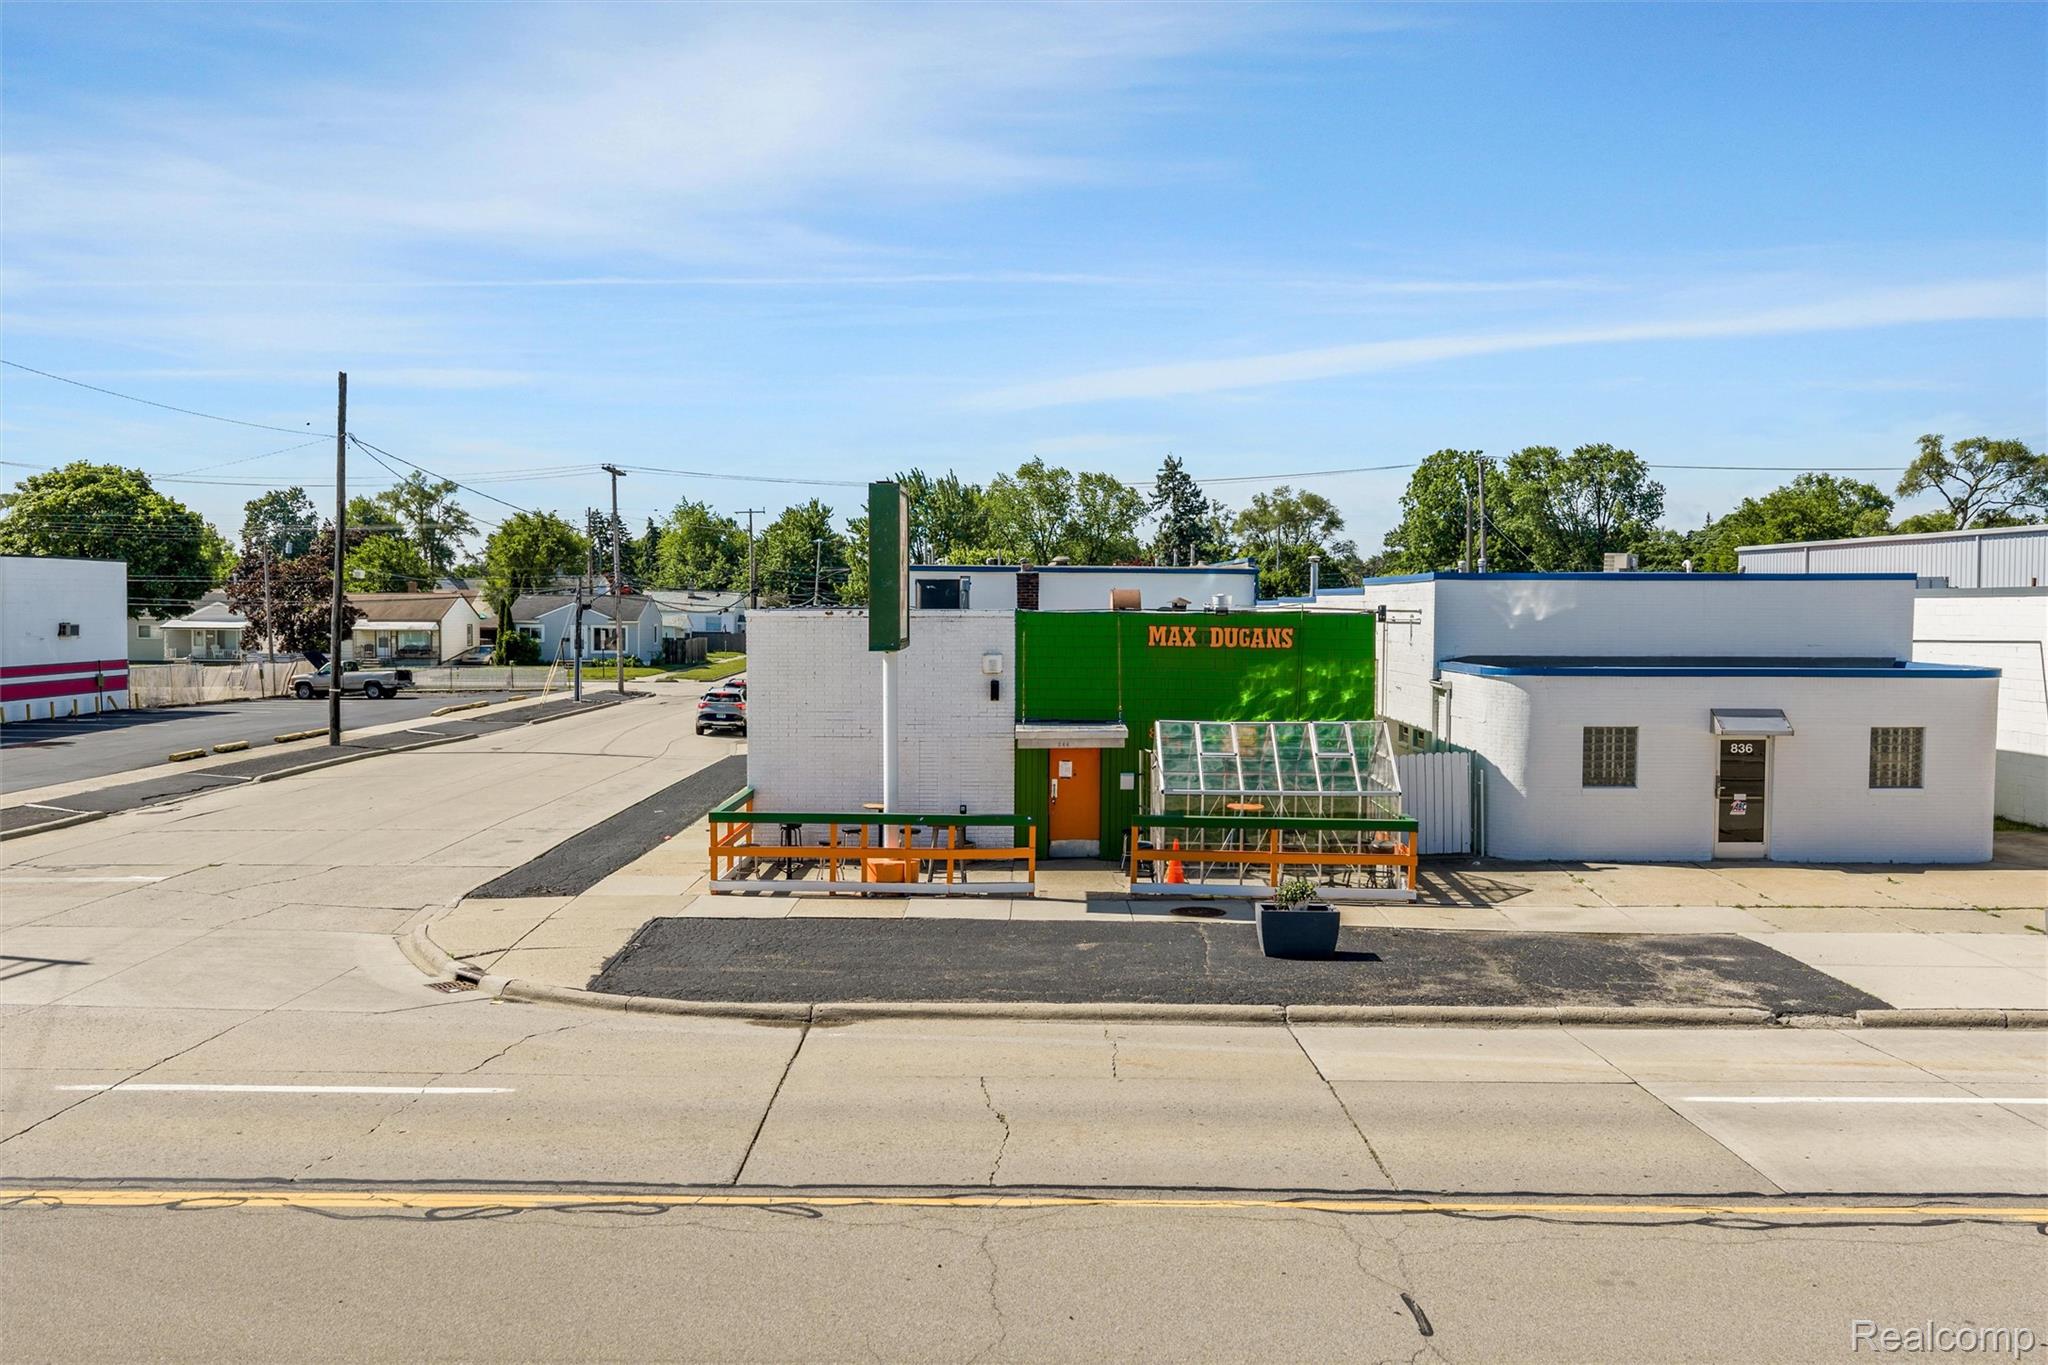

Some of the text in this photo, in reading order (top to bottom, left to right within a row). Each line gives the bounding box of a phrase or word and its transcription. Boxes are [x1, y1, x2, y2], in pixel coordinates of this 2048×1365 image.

[1148, 625, 1294, 648] MAX DUGANS
[1730, 743, 1753, 754] 836
